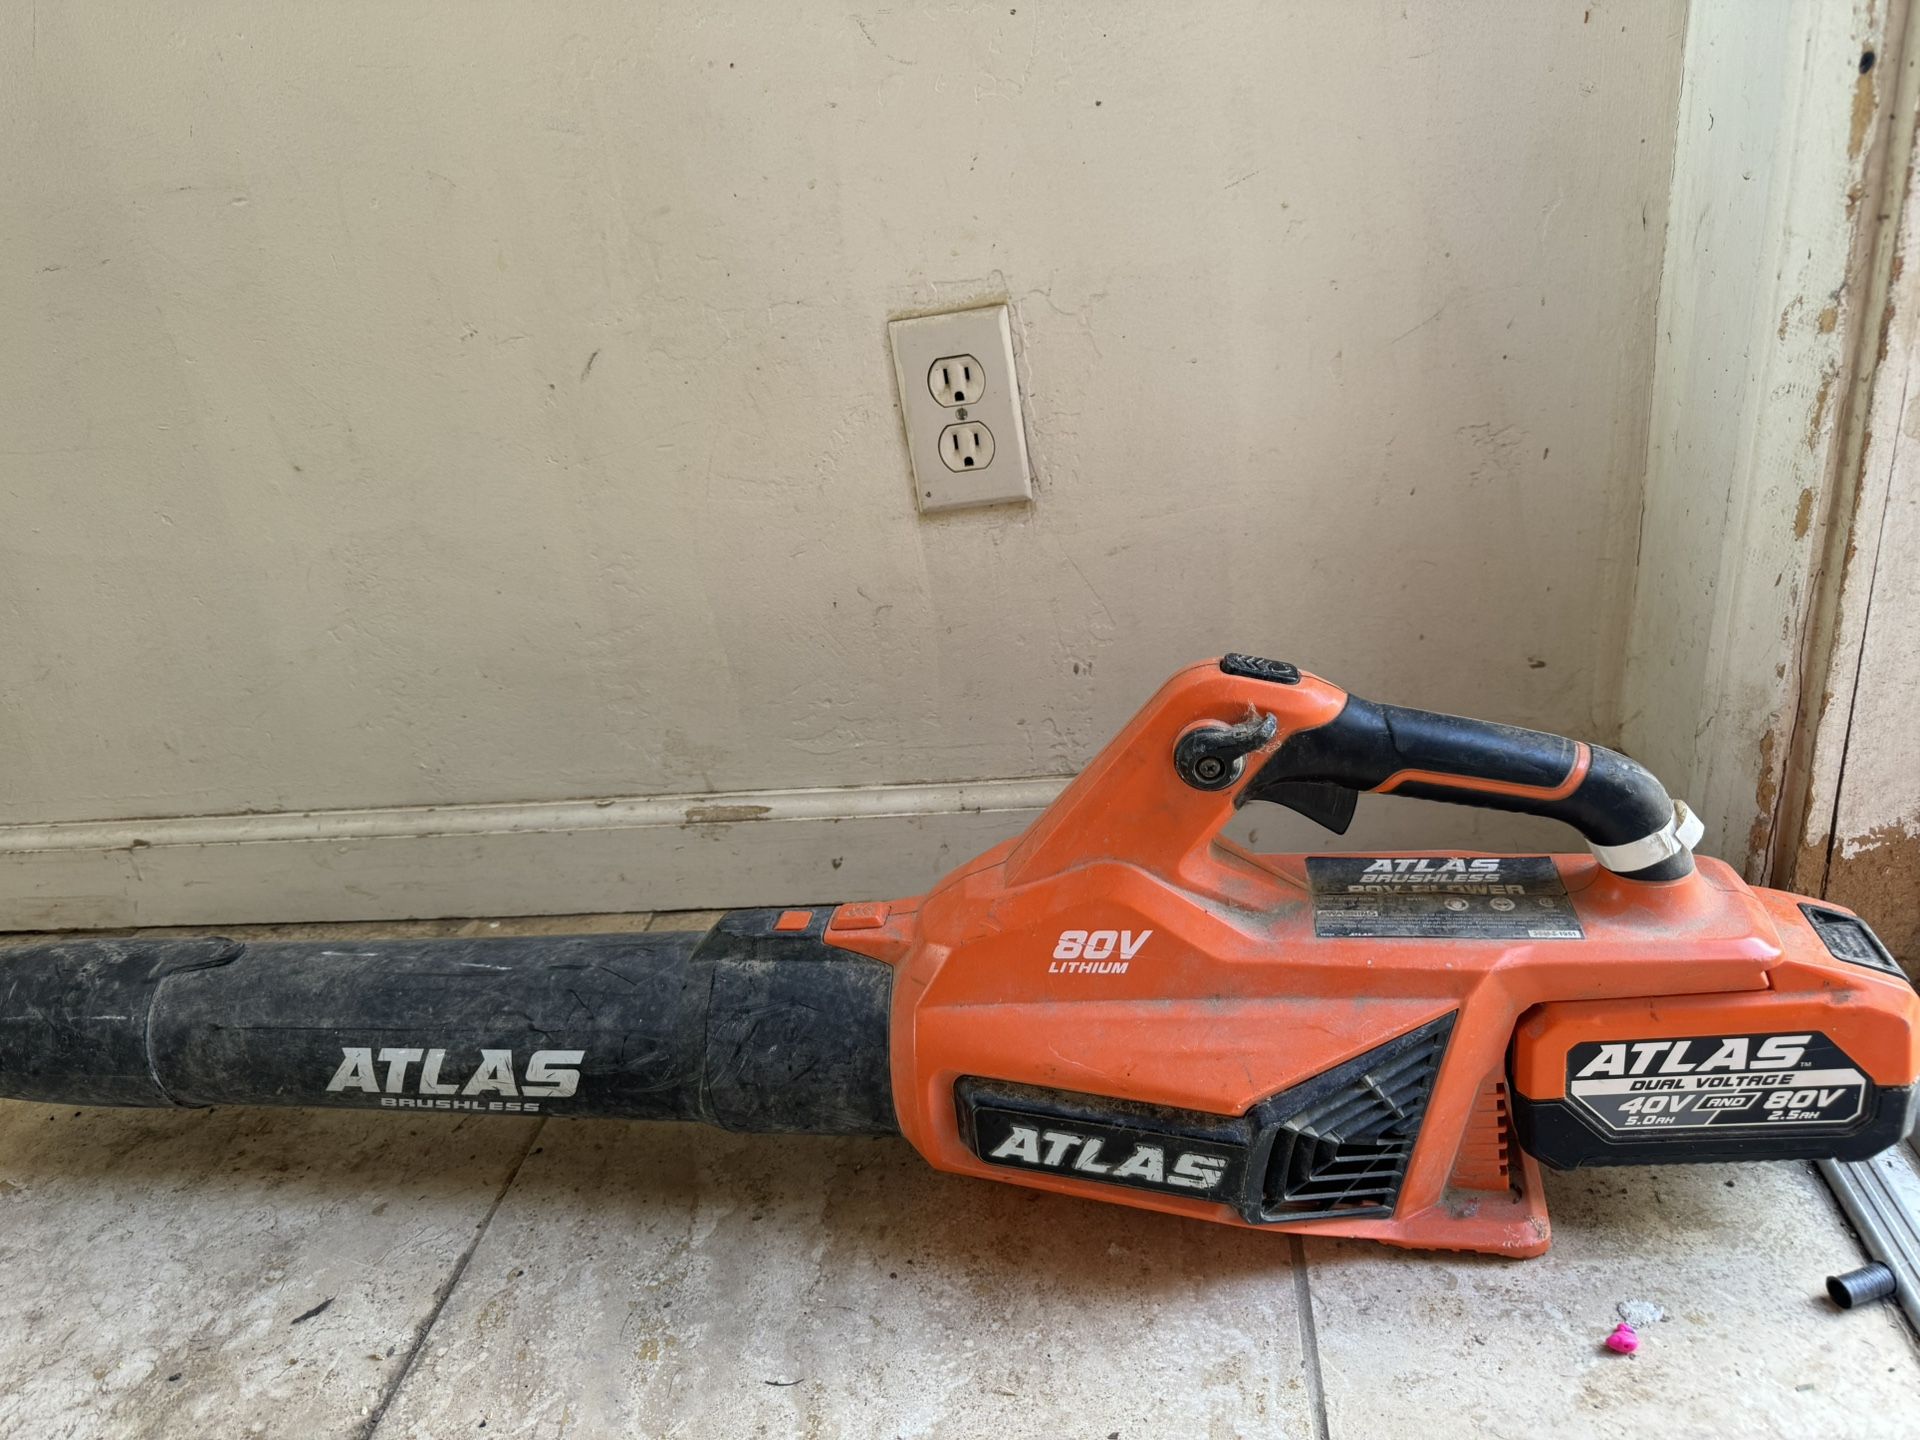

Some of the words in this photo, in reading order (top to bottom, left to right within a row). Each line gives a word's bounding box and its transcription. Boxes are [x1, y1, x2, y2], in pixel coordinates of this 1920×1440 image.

[1362, 858, 1500, 873] ATLAS
[1359, 873, 1500, 883] BRUSHLESS
[1052, 930, 1154, 959] 80V
[1048, 962, 1129, 974] LITHIUM
[1575, 1035, 1813, 1076] ATLAS
[325, 1047, 586, 1098] ATLAS
[1629, 1078, 1685, 1091] DUAL
[1695, 1073, 1795, 1089] VOLTAGE
[380, 1098, 540, 1112] BRUSHLESS
[1618, 1094, 1697, 1114] 40V
[1705, 1096, 1746, 1108] AND
[1763, 1088, 1847, 1109] 80V
[991, 1125, 1229, 1189] ATLAS
